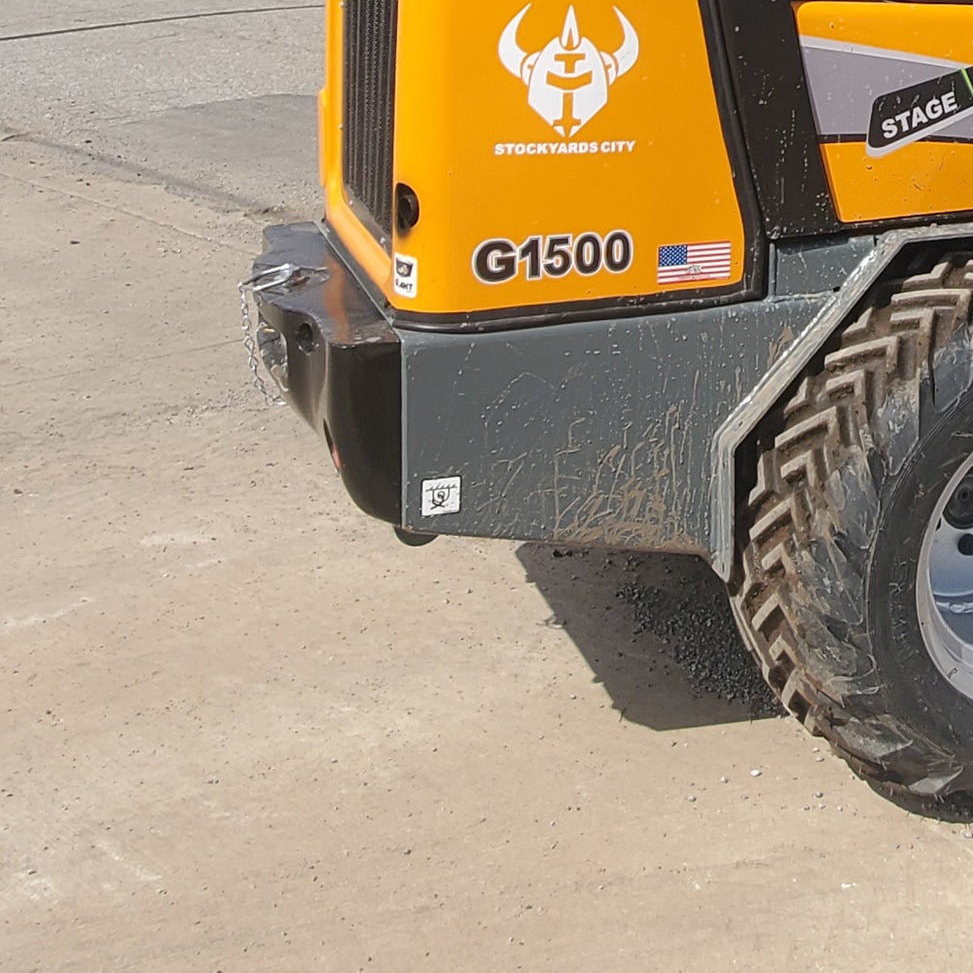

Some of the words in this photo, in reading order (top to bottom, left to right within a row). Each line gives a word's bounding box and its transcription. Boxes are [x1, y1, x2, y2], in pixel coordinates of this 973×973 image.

[881, 92, 958, 139] STAGE
[494, 141, 599, 155] STOCKYARDS
[600, 140, 636, 153] CITY
[472, 230, 634, 285] G1500
